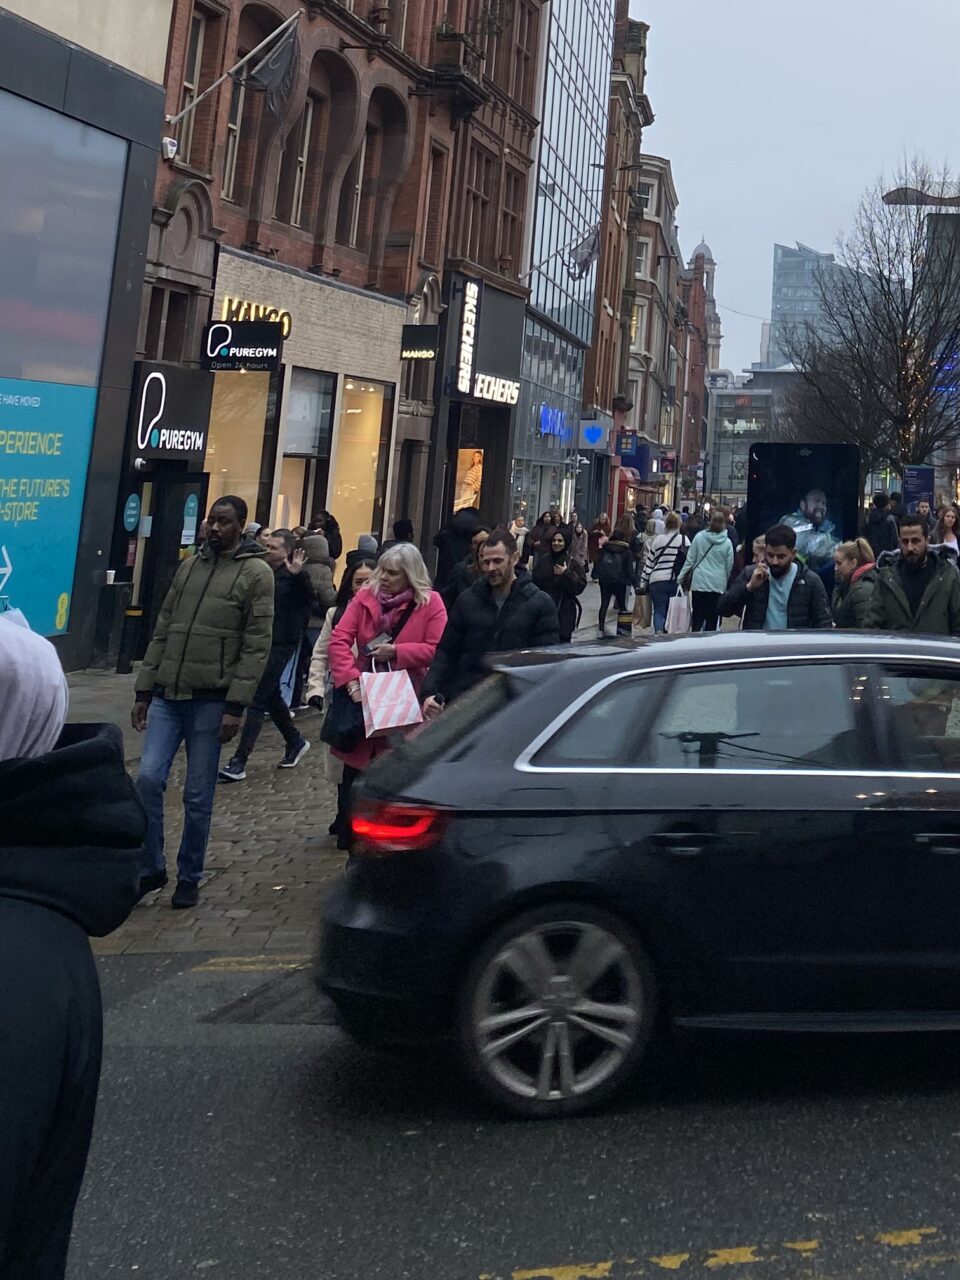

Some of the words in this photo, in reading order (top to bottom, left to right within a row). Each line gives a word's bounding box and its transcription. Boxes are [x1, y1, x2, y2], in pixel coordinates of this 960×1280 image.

[457, 282, 478, 394] SKECHERS
[229, 347, 277, 357] PUREGYM
[402, 350, 435, 358] MANGO
[211, 361, 232, 369] Open
[246, 361, 268, 369] hours
[474, 373, 520, 405] ECHERS
[20, 396, 41, 408] MOVED
[159, 429, 204, 450] PUREGYM
[19, 479, 70, 498] FUTURE'S
[0, 501, 40, 521] -STORE
